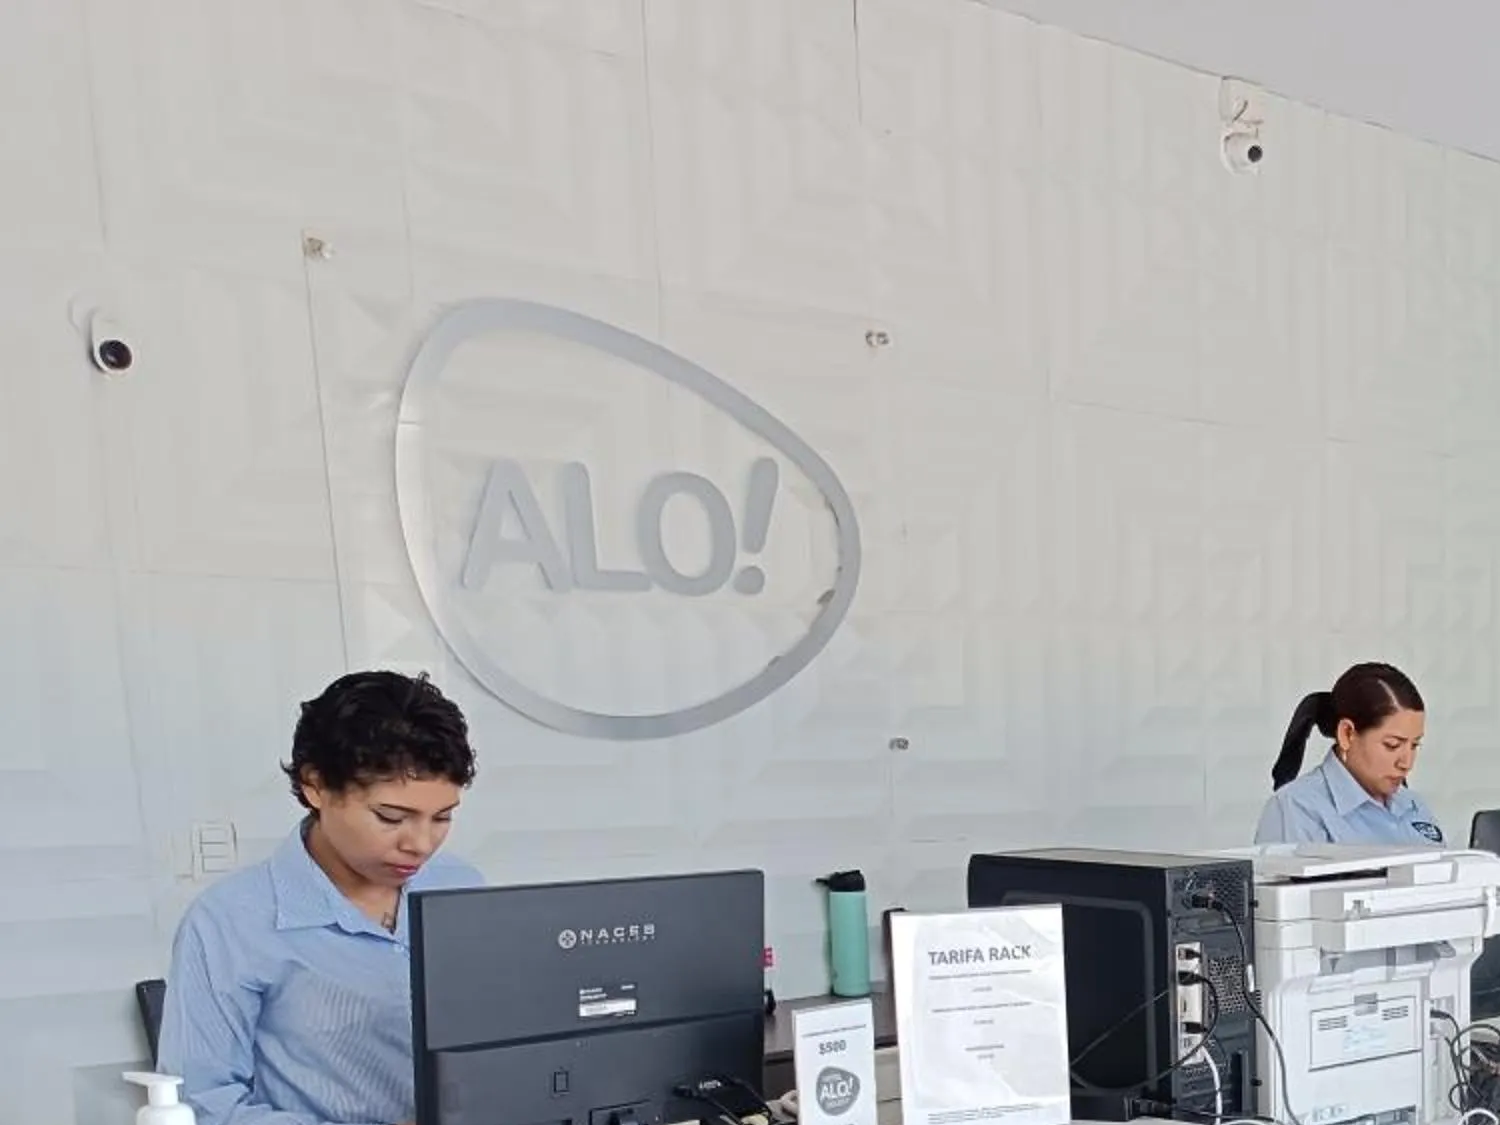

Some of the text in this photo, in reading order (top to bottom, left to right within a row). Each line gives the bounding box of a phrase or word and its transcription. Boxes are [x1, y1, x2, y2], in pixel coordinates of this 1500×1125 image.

[460, 456, 780, 597] ALO!
[928, 944, 1032, 966] TARIFA RACK
[820, 1076, 855, 1101] ALO!
